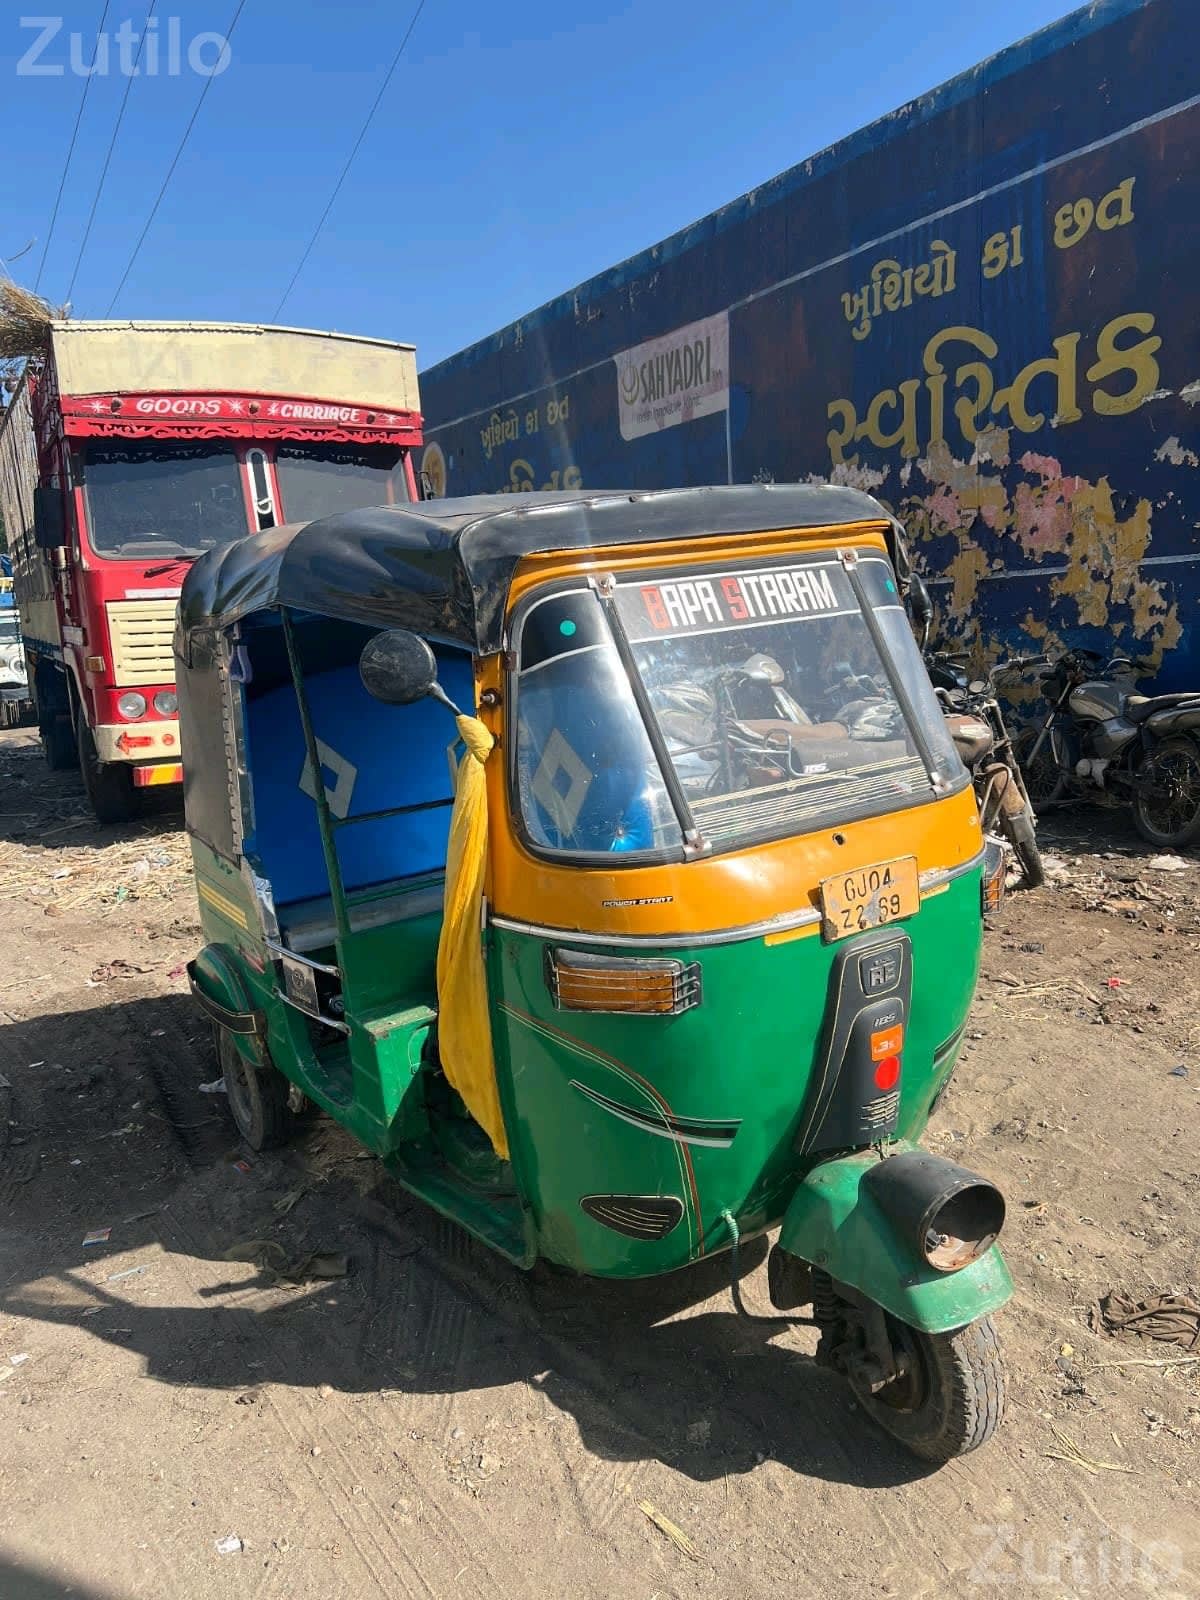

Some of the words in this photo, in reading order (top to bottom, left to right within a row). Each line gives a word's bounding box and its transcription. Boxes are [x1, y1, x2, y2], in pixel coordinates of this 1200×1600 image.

[841, 240, 956, 340] ખુશિયો
[981, 225, 1023, 279] કા
[1054, 176, 1136, 249] છત
[640, 335, 711, 403] SAHYADRI
[136, 398, 222, 416] GOODS
[280, 404, 361, 423] CARRIAGE
[641, 581, 724, 629] BAPA
[720, 569, 839, 620] SITARAM
[843, 867, 892, 902] GJ04
